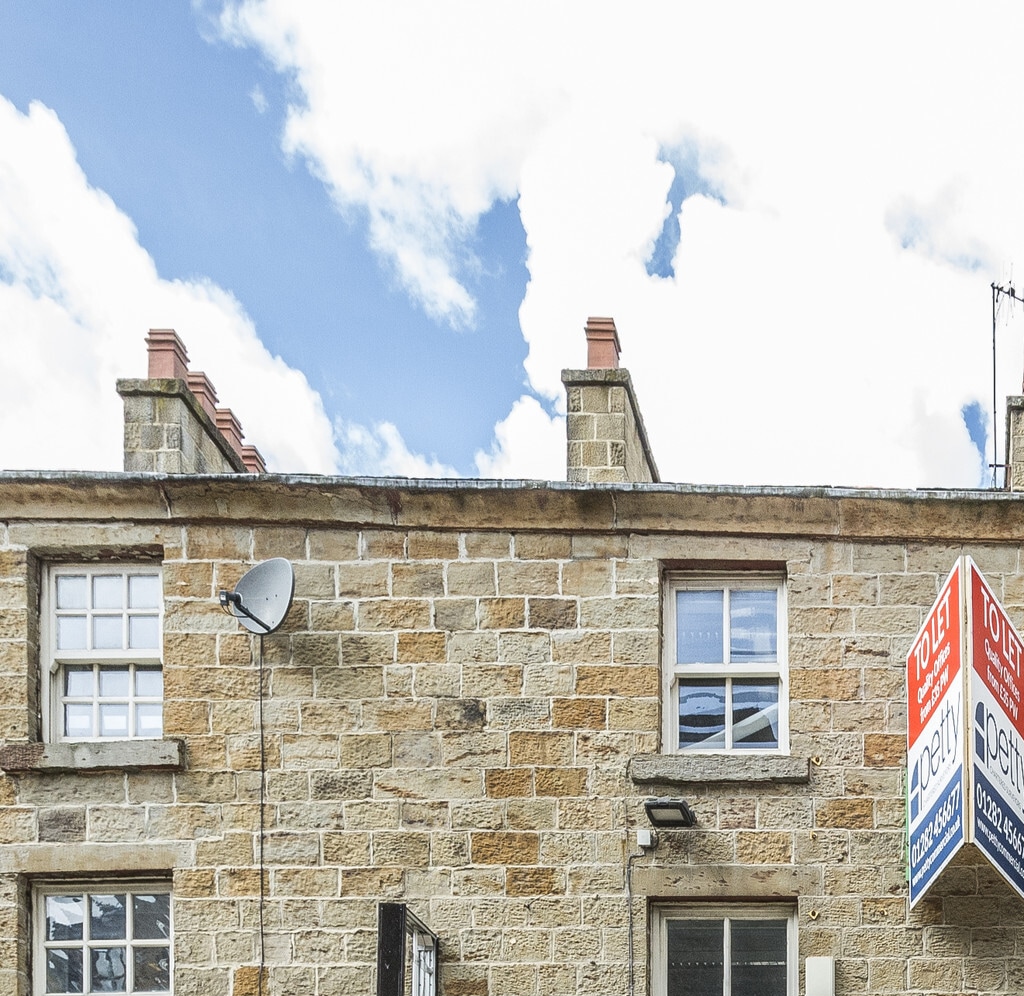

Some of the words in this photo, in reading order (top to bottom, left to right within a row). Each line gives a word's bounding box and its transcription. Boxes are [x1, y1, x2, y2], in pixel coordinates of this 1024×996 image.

[914, 630, 930, 681] TO
[931, 586, 951, 654] LET
[981, 586, 1000, 643] TO
[1001, 619, 1023, 679] LET
[917, 669, 934, 704] Quality
[933, 641, 951, 677] Offices
[919, 694, 931, 725] from
[939, 664, 949, 691] PW
[984, 638, 1003, 679] Quality
[1003, 666, 1021, 703] Offices
[987, 664, 1000, 695] from
[1009, 698, 1019, 721] PW
[919, 690, 961, 811] petty
[911, 821, 934, 869] 01282
[932, 780, 961, 840] 456677
[976, 782, 1003, 834] 01282
